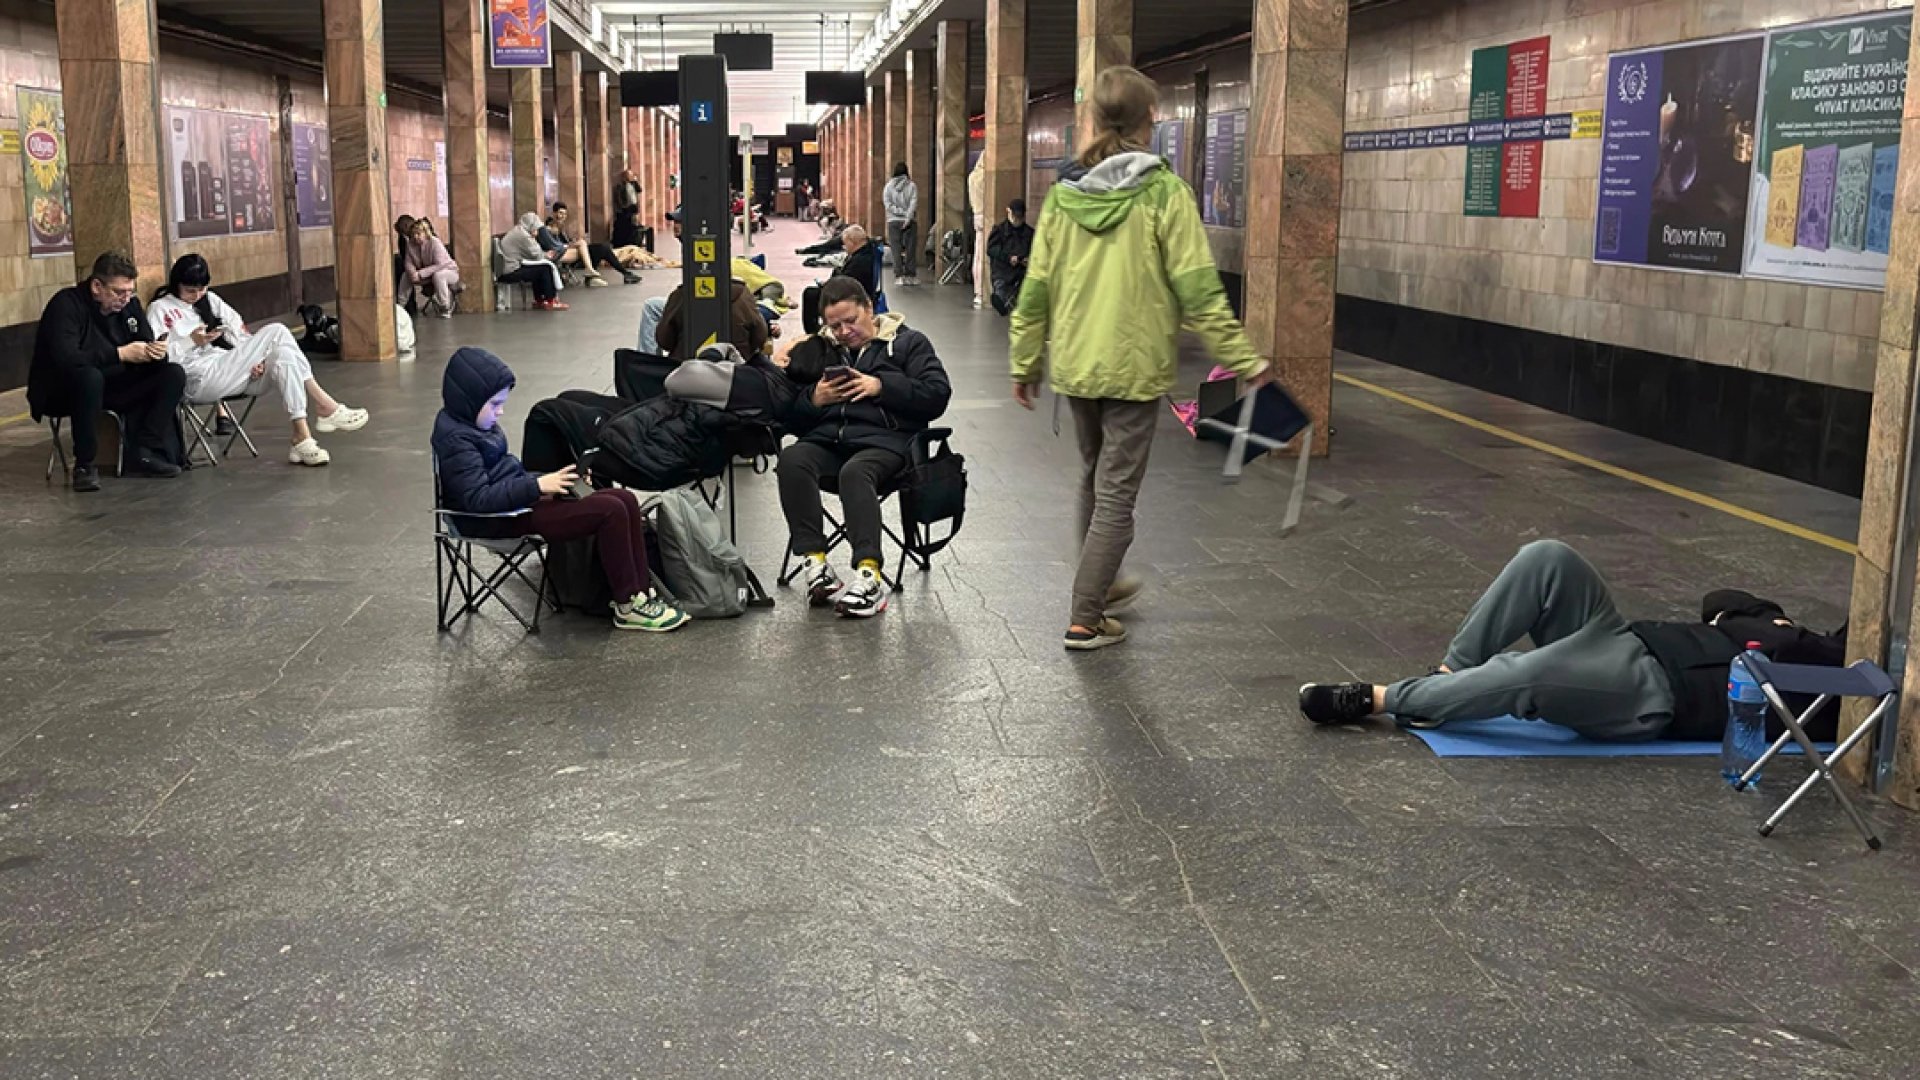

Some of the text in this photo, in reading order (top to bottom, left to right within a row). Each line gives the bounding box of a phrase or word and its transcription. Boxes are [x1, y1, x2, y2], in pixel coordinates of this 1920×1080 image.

[1804, 63, 1860, 83] ВІДКРИЙТЕ
[1791, 84, 1838, 100] КЛАСИКУ
[1840, 80, 1884, 96] ЗАНОВО
[1887, 80, 1897, 93] ІЗ
